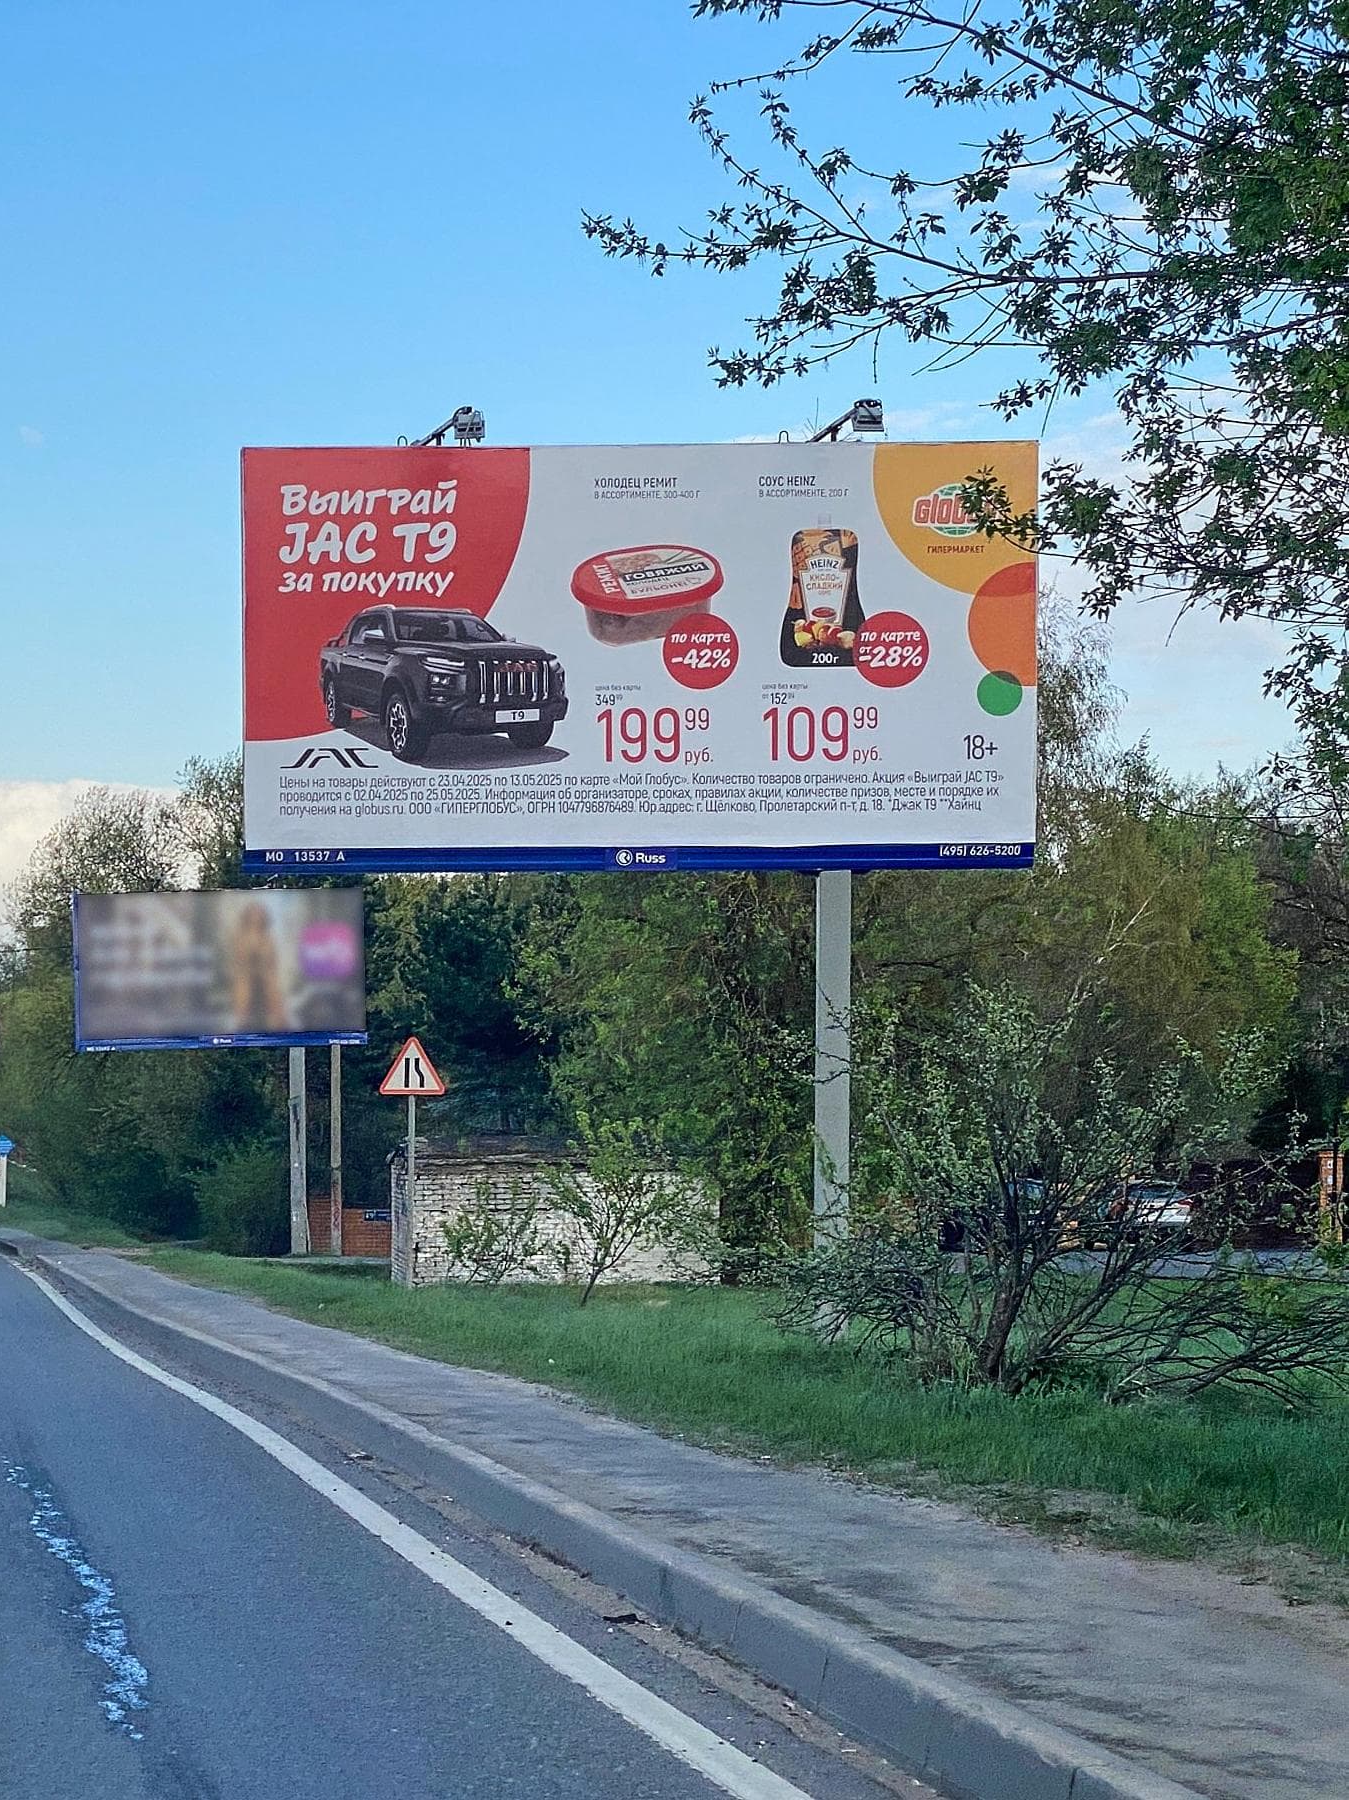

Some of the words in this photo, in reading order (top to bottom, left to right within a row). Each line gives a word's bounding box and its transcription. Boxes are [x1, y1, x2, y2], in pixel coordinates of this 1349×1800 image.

[594, 477, 641, 489] ХОЛОДЕЦ
[644, 477, 678, 488] РЕМИТ
[758, 475, 784, 487] СОУС
[787, 475, 816, 487] HEINZ
[280, 480, 458, 515] Выиграй
[594, 491, 600, 499] В
[758, 490, 764, 498] В
[829, 488, 843, 497] 200
[279, 521, 378, 565] JAC
[392, 521, 457, 563] T9
[927, 545, 985, 554] ГИПЕРМАРКЕТ
[810, 558, 839, 570] HEINZ
[278, 572, 314, 592] за
[322, 571, 455, 598] покупку
[592, 564, 620, 595] РЕМИТ
[671, 633, 686, 643] по
[691, 632, 731, 645] карте
[860, 632, 876, 642] по
[880, 630, 921, 642] карте
[671, 648, 731, 669] -42%
[812, 653, 839, 664] 200г
[859, 646, 872, 654] от
[859, 646, 922, 668] -28%
[595, 693, 616, 706] 349
[770, 692, 788, 704] 152
[511, 711, 525, 720] T9
[684, 708, 710, 730] 99
[853, 706, 878, 729] 99
[597, 707, 681, 763] 199
[763, 706, 849, 761] 109
[852, 746, 882, 764] руб.
[963, 734, 998, 760] 18+
[280, 748, 378, 768] JAC
[684, 747, 714, 766] руб.
[280, 776, 310, 789] Цены
[312, 778, 325, 788] на
[329, 778, 368, 790] товары
[370, 775, 426, 790] действуют
[429, 777, 436, 786] с
[437, 774, 491, 786] 23.04.2025
[494, 776, 507, 786] по
[510, 774, 562, 786] 13.05.2025
[564, 776, 577, 786] по
[580, 775, 610, 787] карте
[612, 772, 642, 786] «Мой
[692, 772, 755, 785] Количество
[758, 774, 801, 786] товаров
[804, 773, 870, 786] ограничено.
[872, 771, 905, 784] Акция
[907, 770, 962, 785] «Выиграй
[964, 770, 982, 783] JAC
[280, 791, 342, 803] проводится
[344, 791, 351, 801] с
[353, 788, 409, 801] 02.04.2025
[411, 790, 424, 800] по
[485, 787, 555, 803] Информация
[558, 787, 571, 799] об
[574, 788, 650, 801] организаторе,
[652, 788, 691, 801] сроках,
[695, 788, 746, 800] правилах
[748, 787, 783, 799] акции,
[786, 787, 848, 798] количестве
[851, 787, 891, 799] призов,
[894, 787, 926, 797] месте
[929, 787, 936, 796] и
[938, 786, 984, 800] порядке
[986, 787, 999, 796] их
[280, 805, 336, 818] получения
[339, 805, 352, 815] на
[409, 802, 431, 814] ООО
[434, 801, 525, 815] «ГИПЕРГЛОБУС»,
[527, 801, 556, 814] ОГРН
[639, 801, 694, 814] Юр.адрес:
[696, 802, 703, 813] г.
[759, 799, 837, 813] Пролетарский
[840, 801, 857, 813] п-т,
[859, 801, 869, 812] д.
[872, 799, 885, 811] 18.
[924, 798, 937, 810] T9
[265, 851, 284, 861] МО
[294, 851, 330, 861] 13537
[635, 852, 666, 863] Russ
[970, 844, 1021, 856] 626-5200
